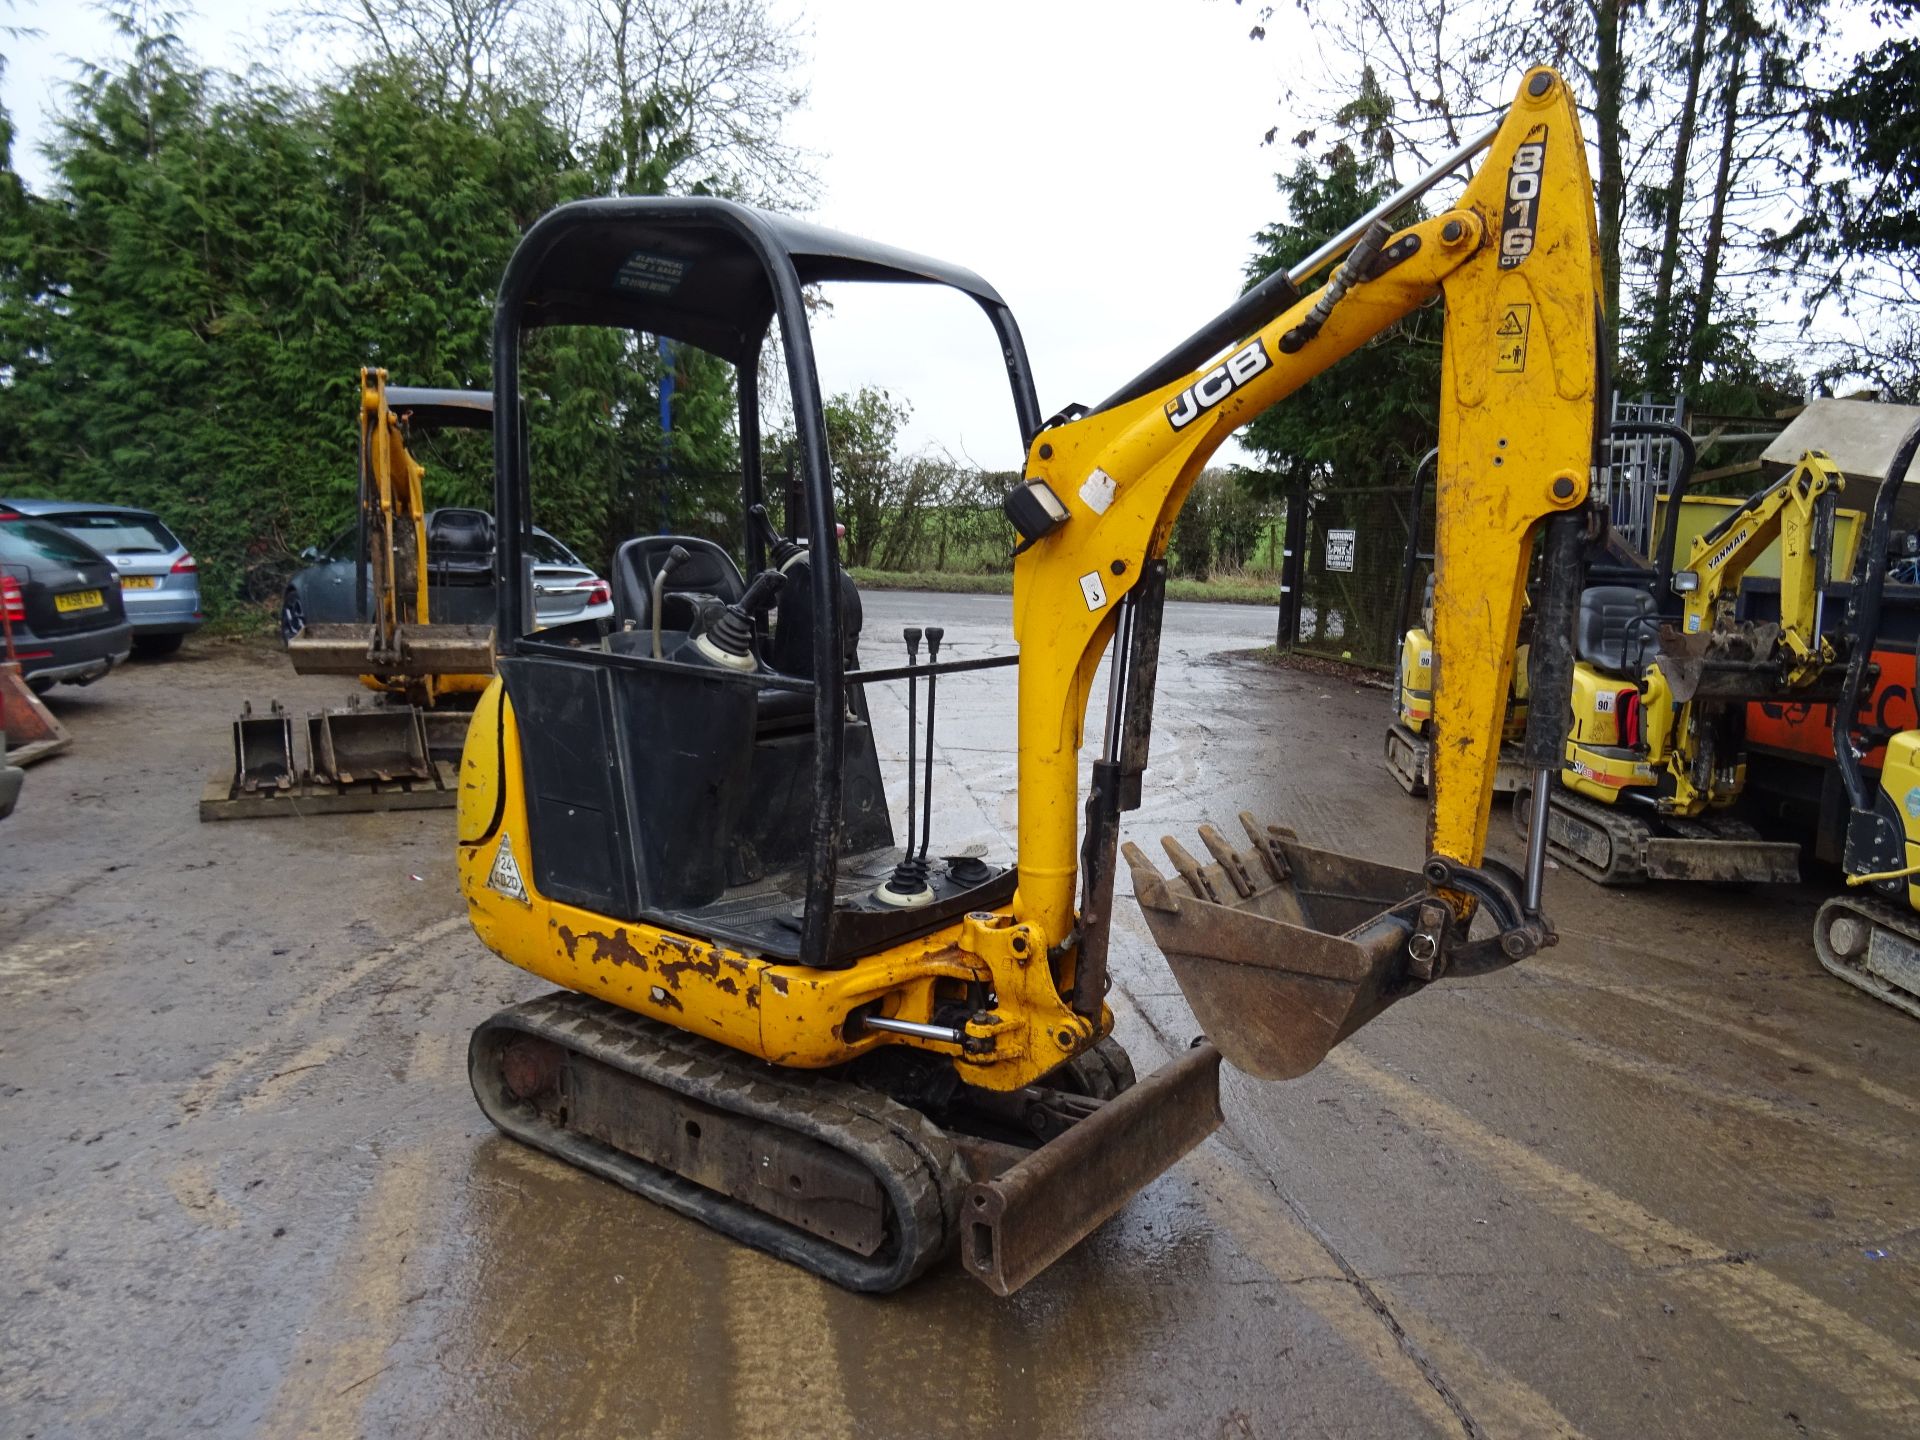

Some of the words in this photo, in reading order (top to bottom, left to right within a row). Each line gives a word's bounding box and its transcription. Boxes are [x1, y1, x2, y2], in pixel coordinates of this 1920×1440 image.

[1502, 145, 1543, 256] 8016
[1170, 342, 1267, 427] JCB
[1329, 532, 1353, 541] WARNING
[1708, 529, 1747, 569] YANMAR
[1597, 700, 1609, 711] 90
[501, 856, 512, 871] 24
